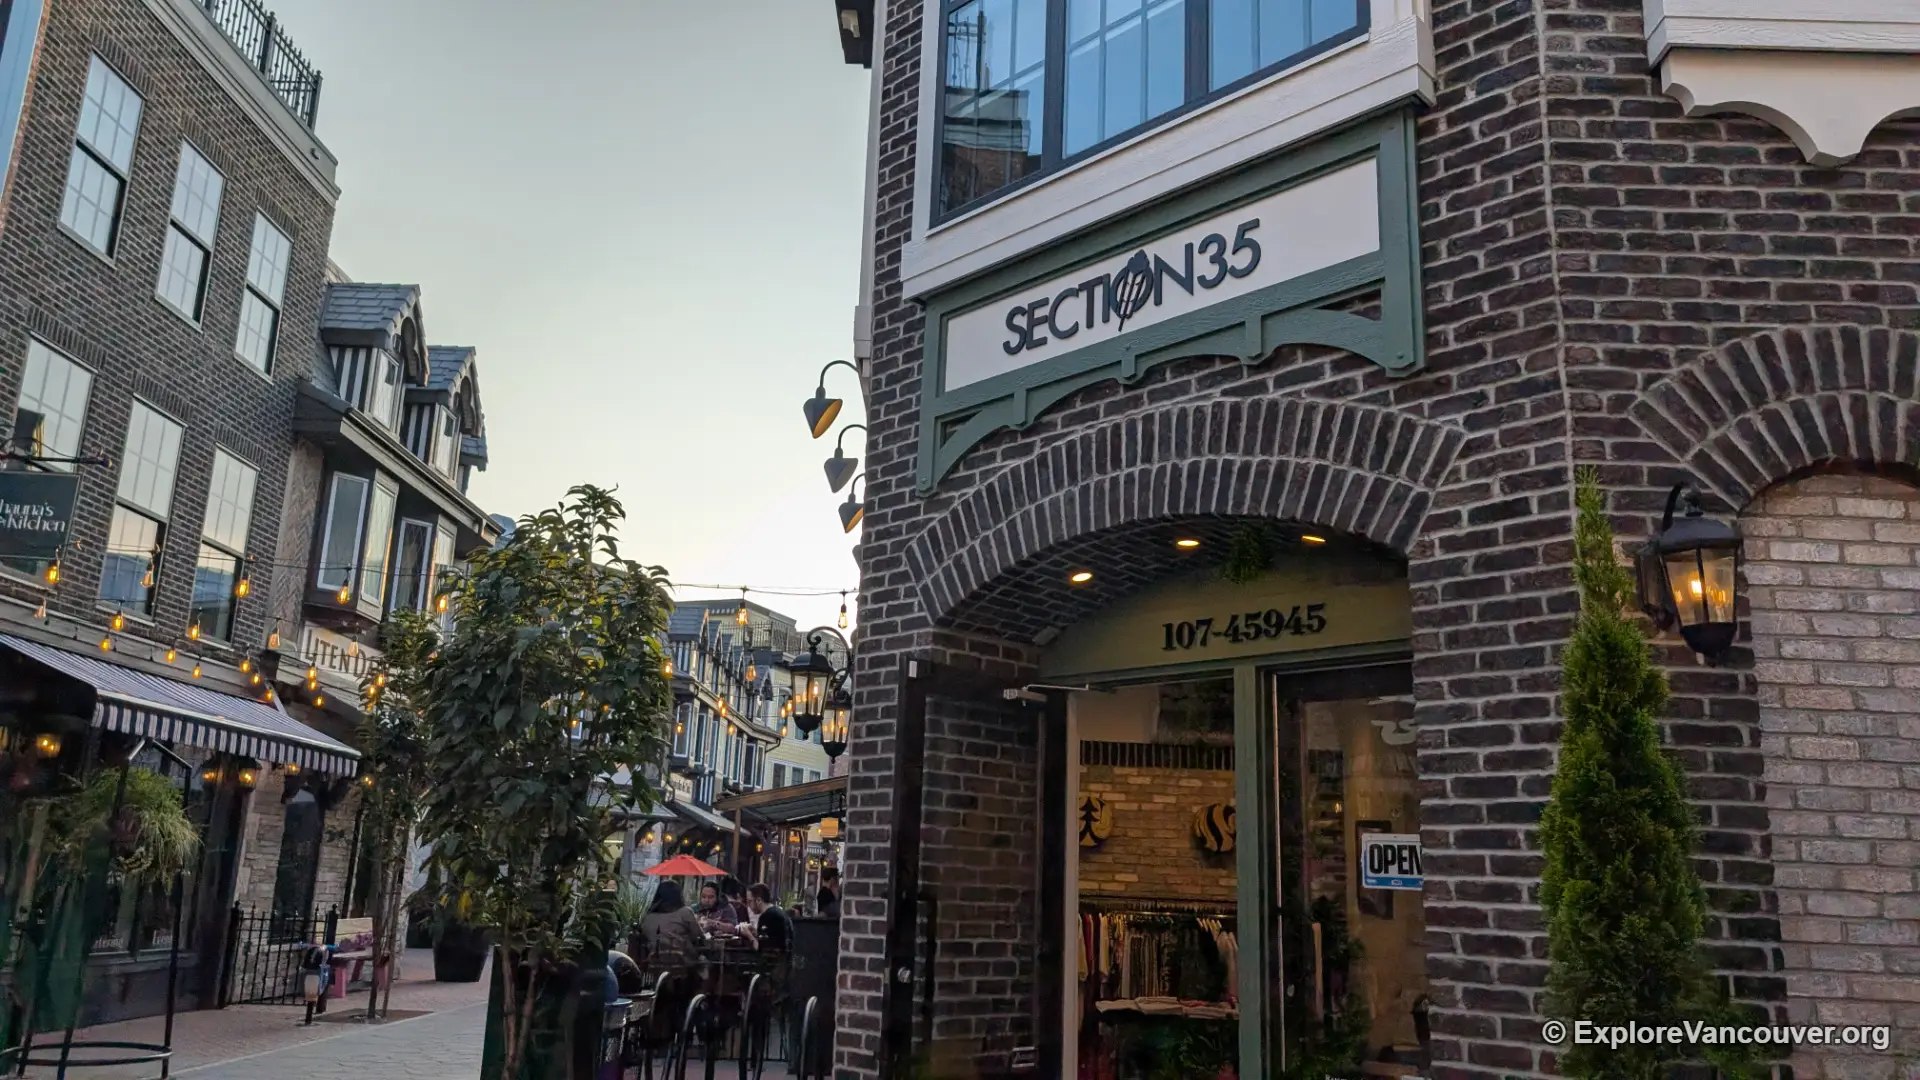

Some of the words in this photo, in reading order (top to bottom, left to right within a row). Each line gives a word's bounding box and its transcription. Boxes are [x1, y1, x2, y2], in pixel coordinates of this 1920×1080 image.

[1003, 218, 1261, 355] SECTION35
[1162, 603, 1327, 650] 107-45945
[1369, 843, 1423, 875] OPEN
